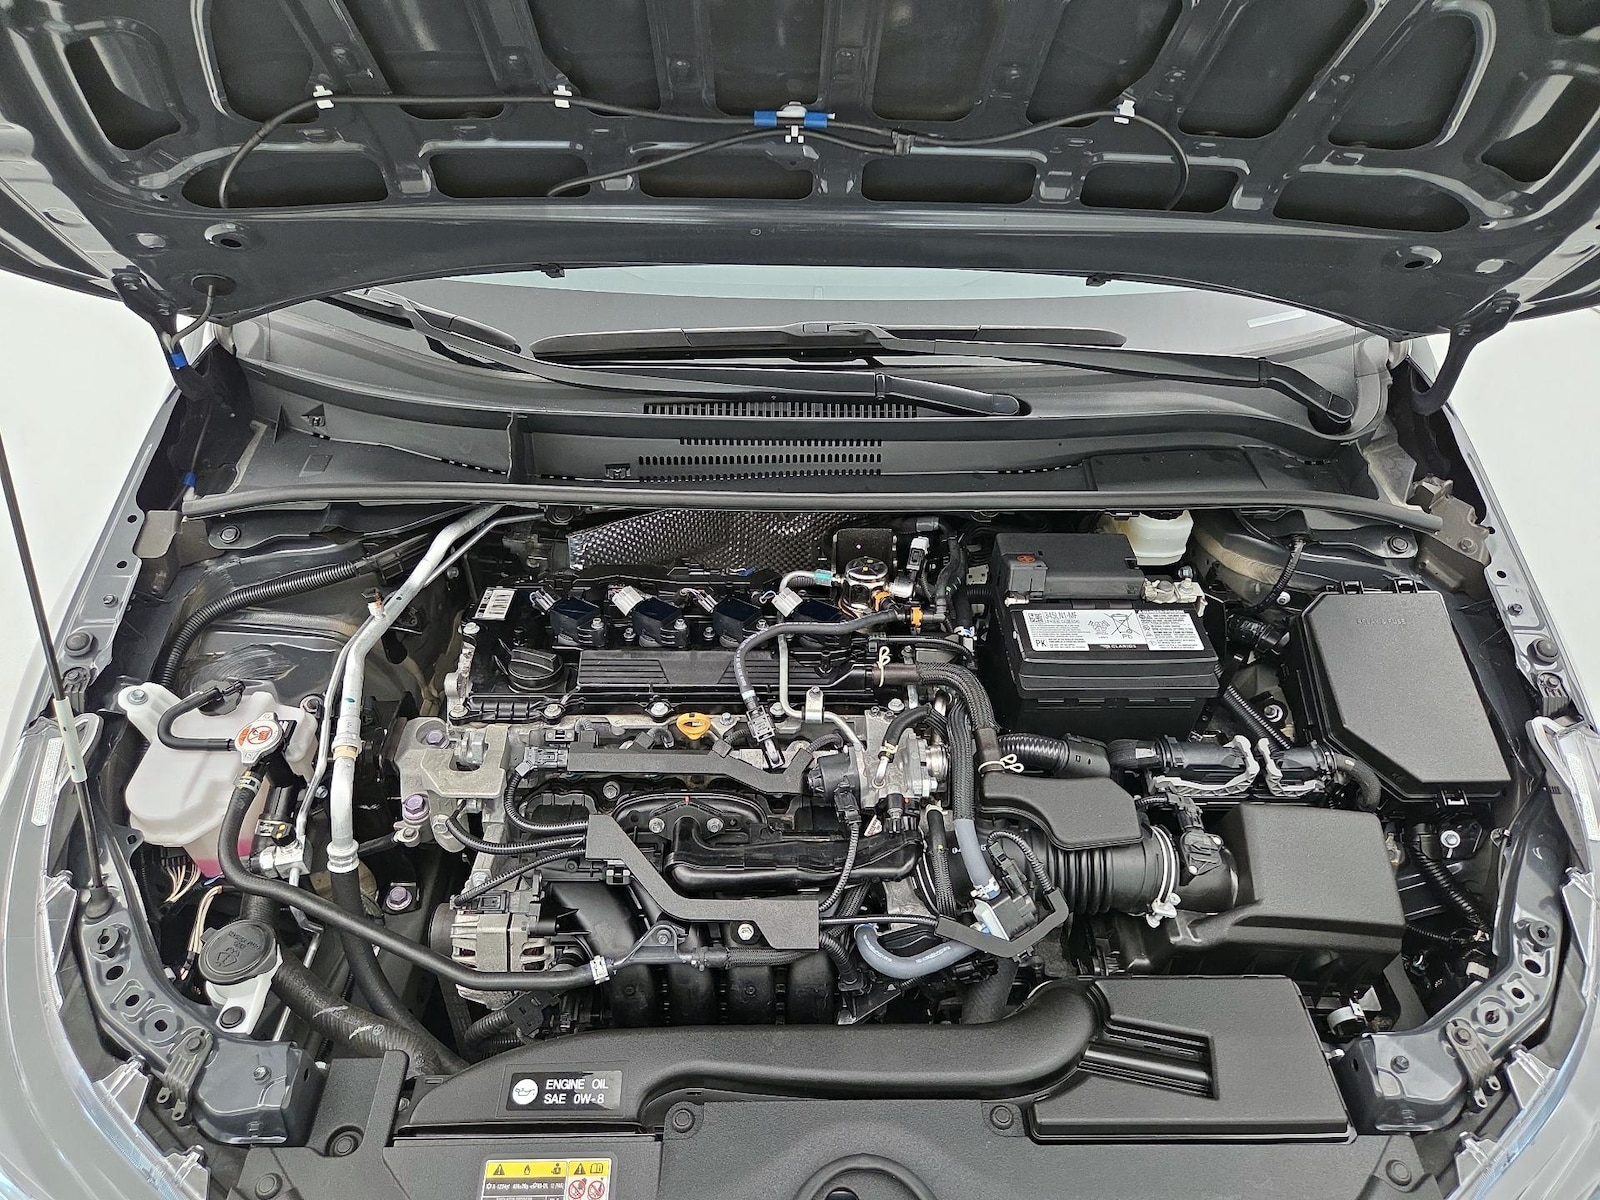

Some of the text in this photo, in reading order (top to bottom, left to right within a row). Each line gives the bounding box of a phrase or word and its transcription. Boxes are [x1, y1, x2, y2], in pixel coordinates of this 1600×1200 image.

[1035, 639, 1047, 648] PK
[545, 1078, 609, 1090] ENGINE OIL
[543, 1093, 605, 1104] SAE 0W-8
